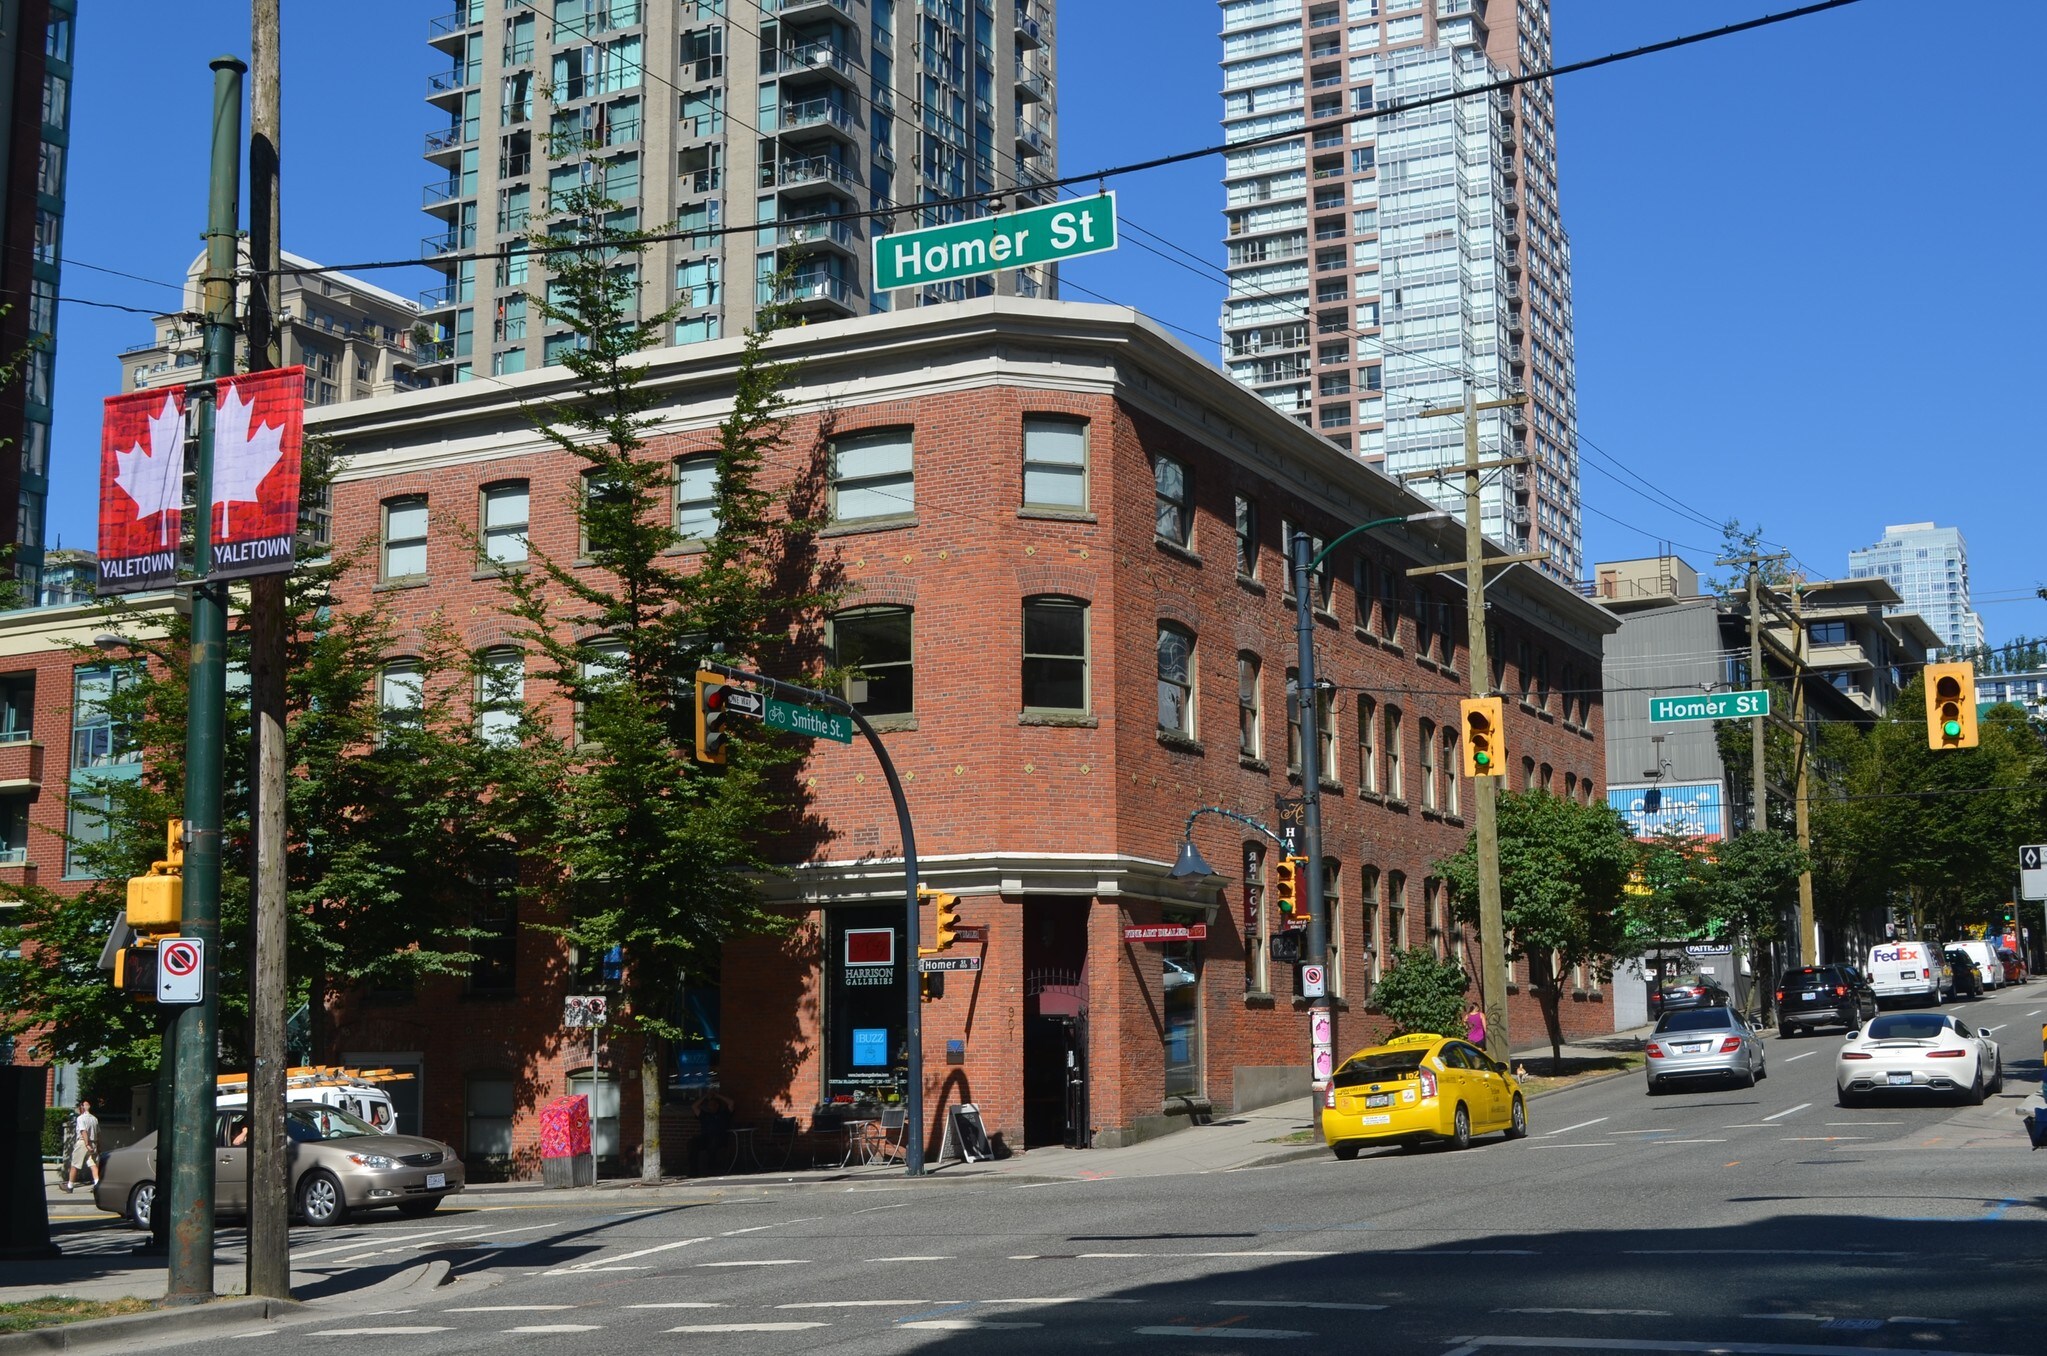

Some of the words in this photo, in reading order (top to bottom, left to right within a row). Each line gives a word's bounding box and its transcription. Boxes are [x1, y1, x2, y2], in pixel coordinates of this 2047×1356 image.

[894, 229, 1029, 278] Homer
[1050, 210, 1095, 250] St
[214, 536, 291, 564] YALETOWN
[100, 552, 175, 578] YALETOWN
[728, 693, 740, 704] ONE
[740, 697, 751, 707] WAY
[1659, 701, 1727, 718] Homer
[1736, 696, 1759, 713] St
[791, 709, 828, 734] Smithe
[829, 719, 844, 738] St.
[1630, 796, 1699, 817] Oline
[1873, 947, 1918, 962] FedEx
[845, 968, 894, 978] HARRISON
[925, 960, 956, 970] Homer
[859, 1033, 884, 1043] BUZZ
[1406, 1070, 1420, 1080] 102
